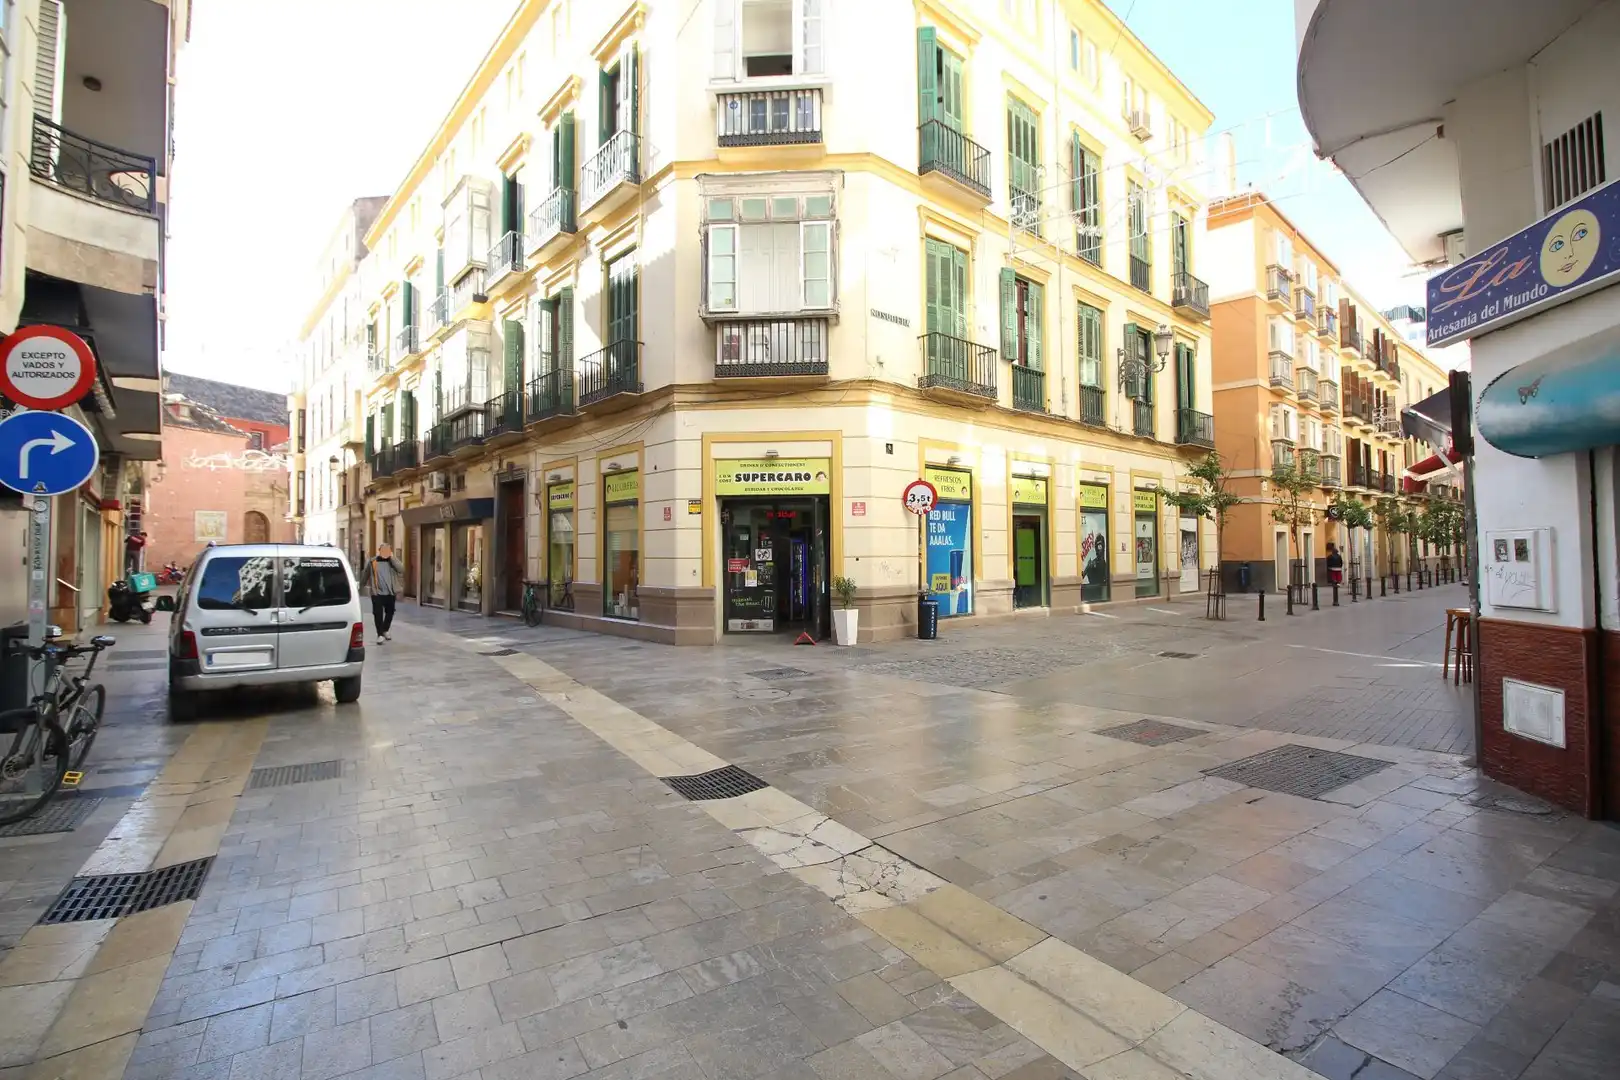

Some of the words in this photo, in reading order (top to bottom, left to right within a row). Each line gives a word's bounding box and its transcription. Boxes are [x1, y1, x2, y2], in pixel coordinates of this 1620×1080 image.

[1432, 247, 1533, 314] La
[1428, 311, 1477, 341] Artesanía
[1481, 300, 1500, 320] del
[1503, 284, 1548, 312] Mundo
[21, 351, 66, 360] EXCEPTO
[22, 361, 55, 369] VADOS
[58, 361, 65, 369] Y
[12, 371, 76, 379] AUTORIZADOS
[735, 472, 812, 483] SUPERCARO
[934, 474, 962, 484] REFRESCOS
[929, 510, 941, 521] RED
[942, 510, 956, 522] BULL
[929, 522, 937, 533] TE
[937, 522, 946, 533] DA
